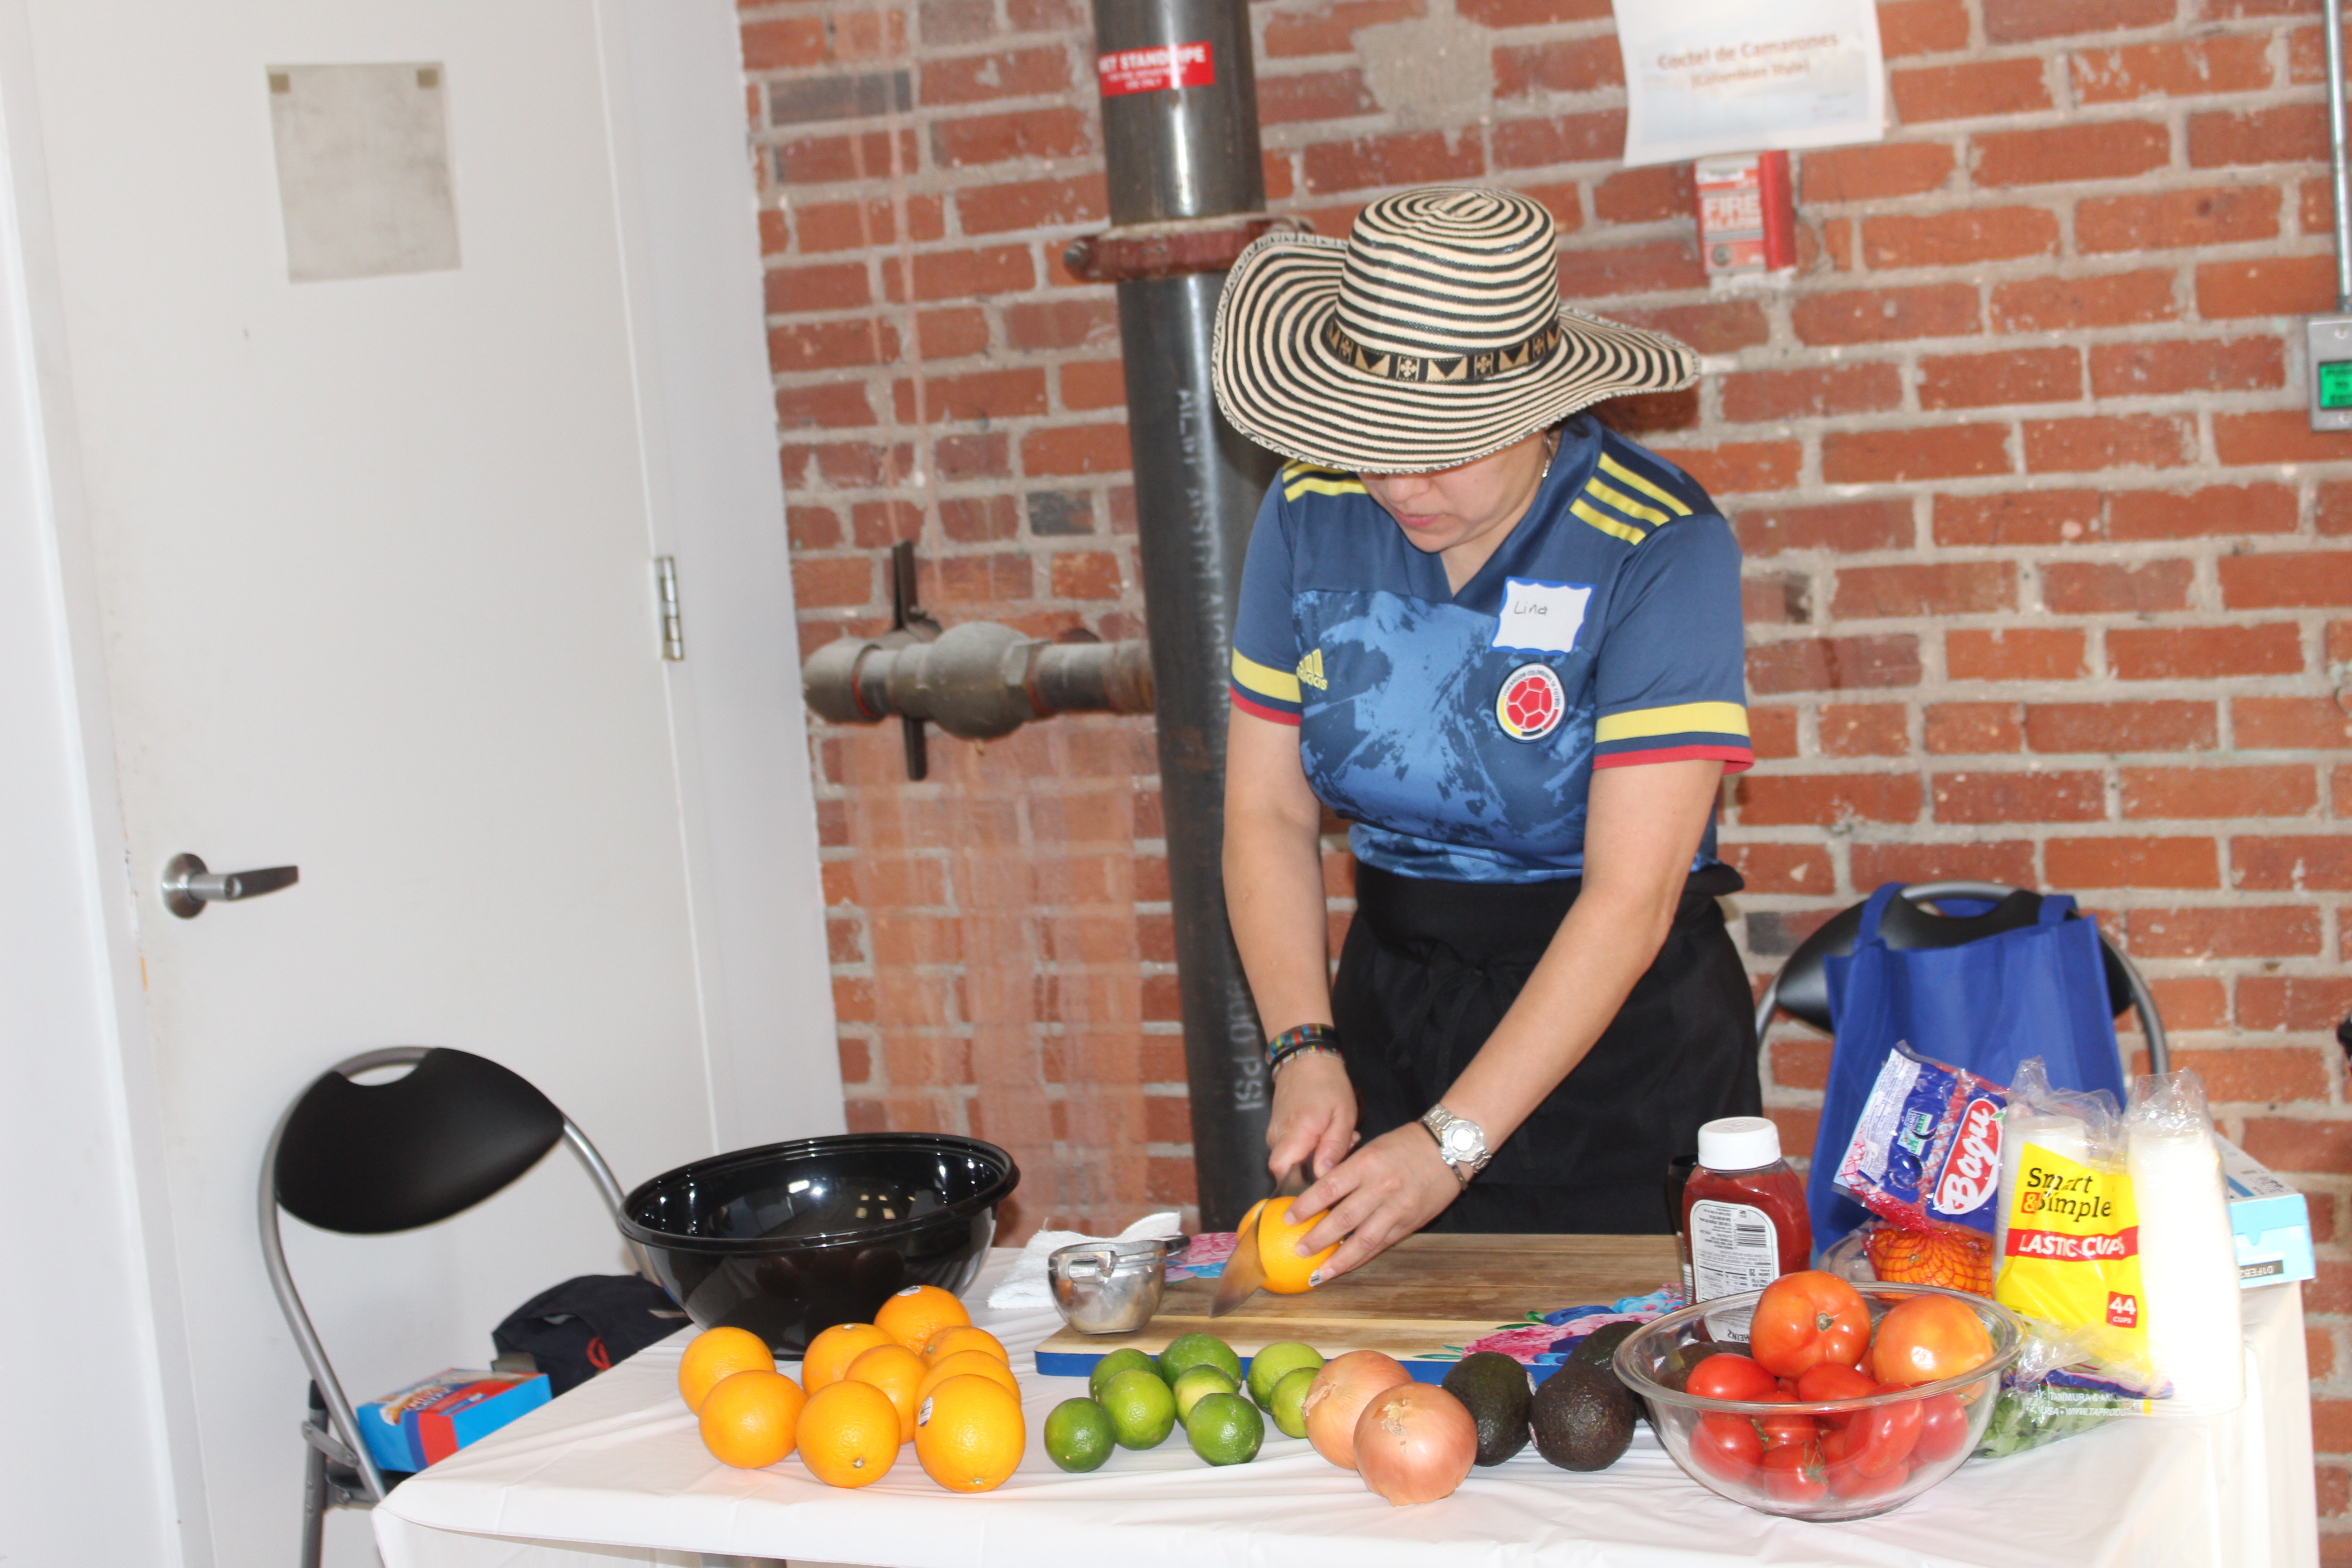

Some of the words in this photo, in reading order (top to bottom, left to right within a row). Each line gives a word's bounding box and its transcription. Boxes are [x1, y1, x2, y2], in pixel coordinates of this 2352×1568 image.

[1120, 45, 1205, 71] STANDIPE
[1657, 47, 1710, 69] Coctel
[1715, 47, 1736, 62] de
[1741, 33, 1838, 59] Camarones
[1704, 195, 1761, 218] FIRE
[1514, 601, 1548, 616] Lina
[2109, 1296, 2136, 1316] 44
[2112, 1316, 2132, 1324] CUPS
